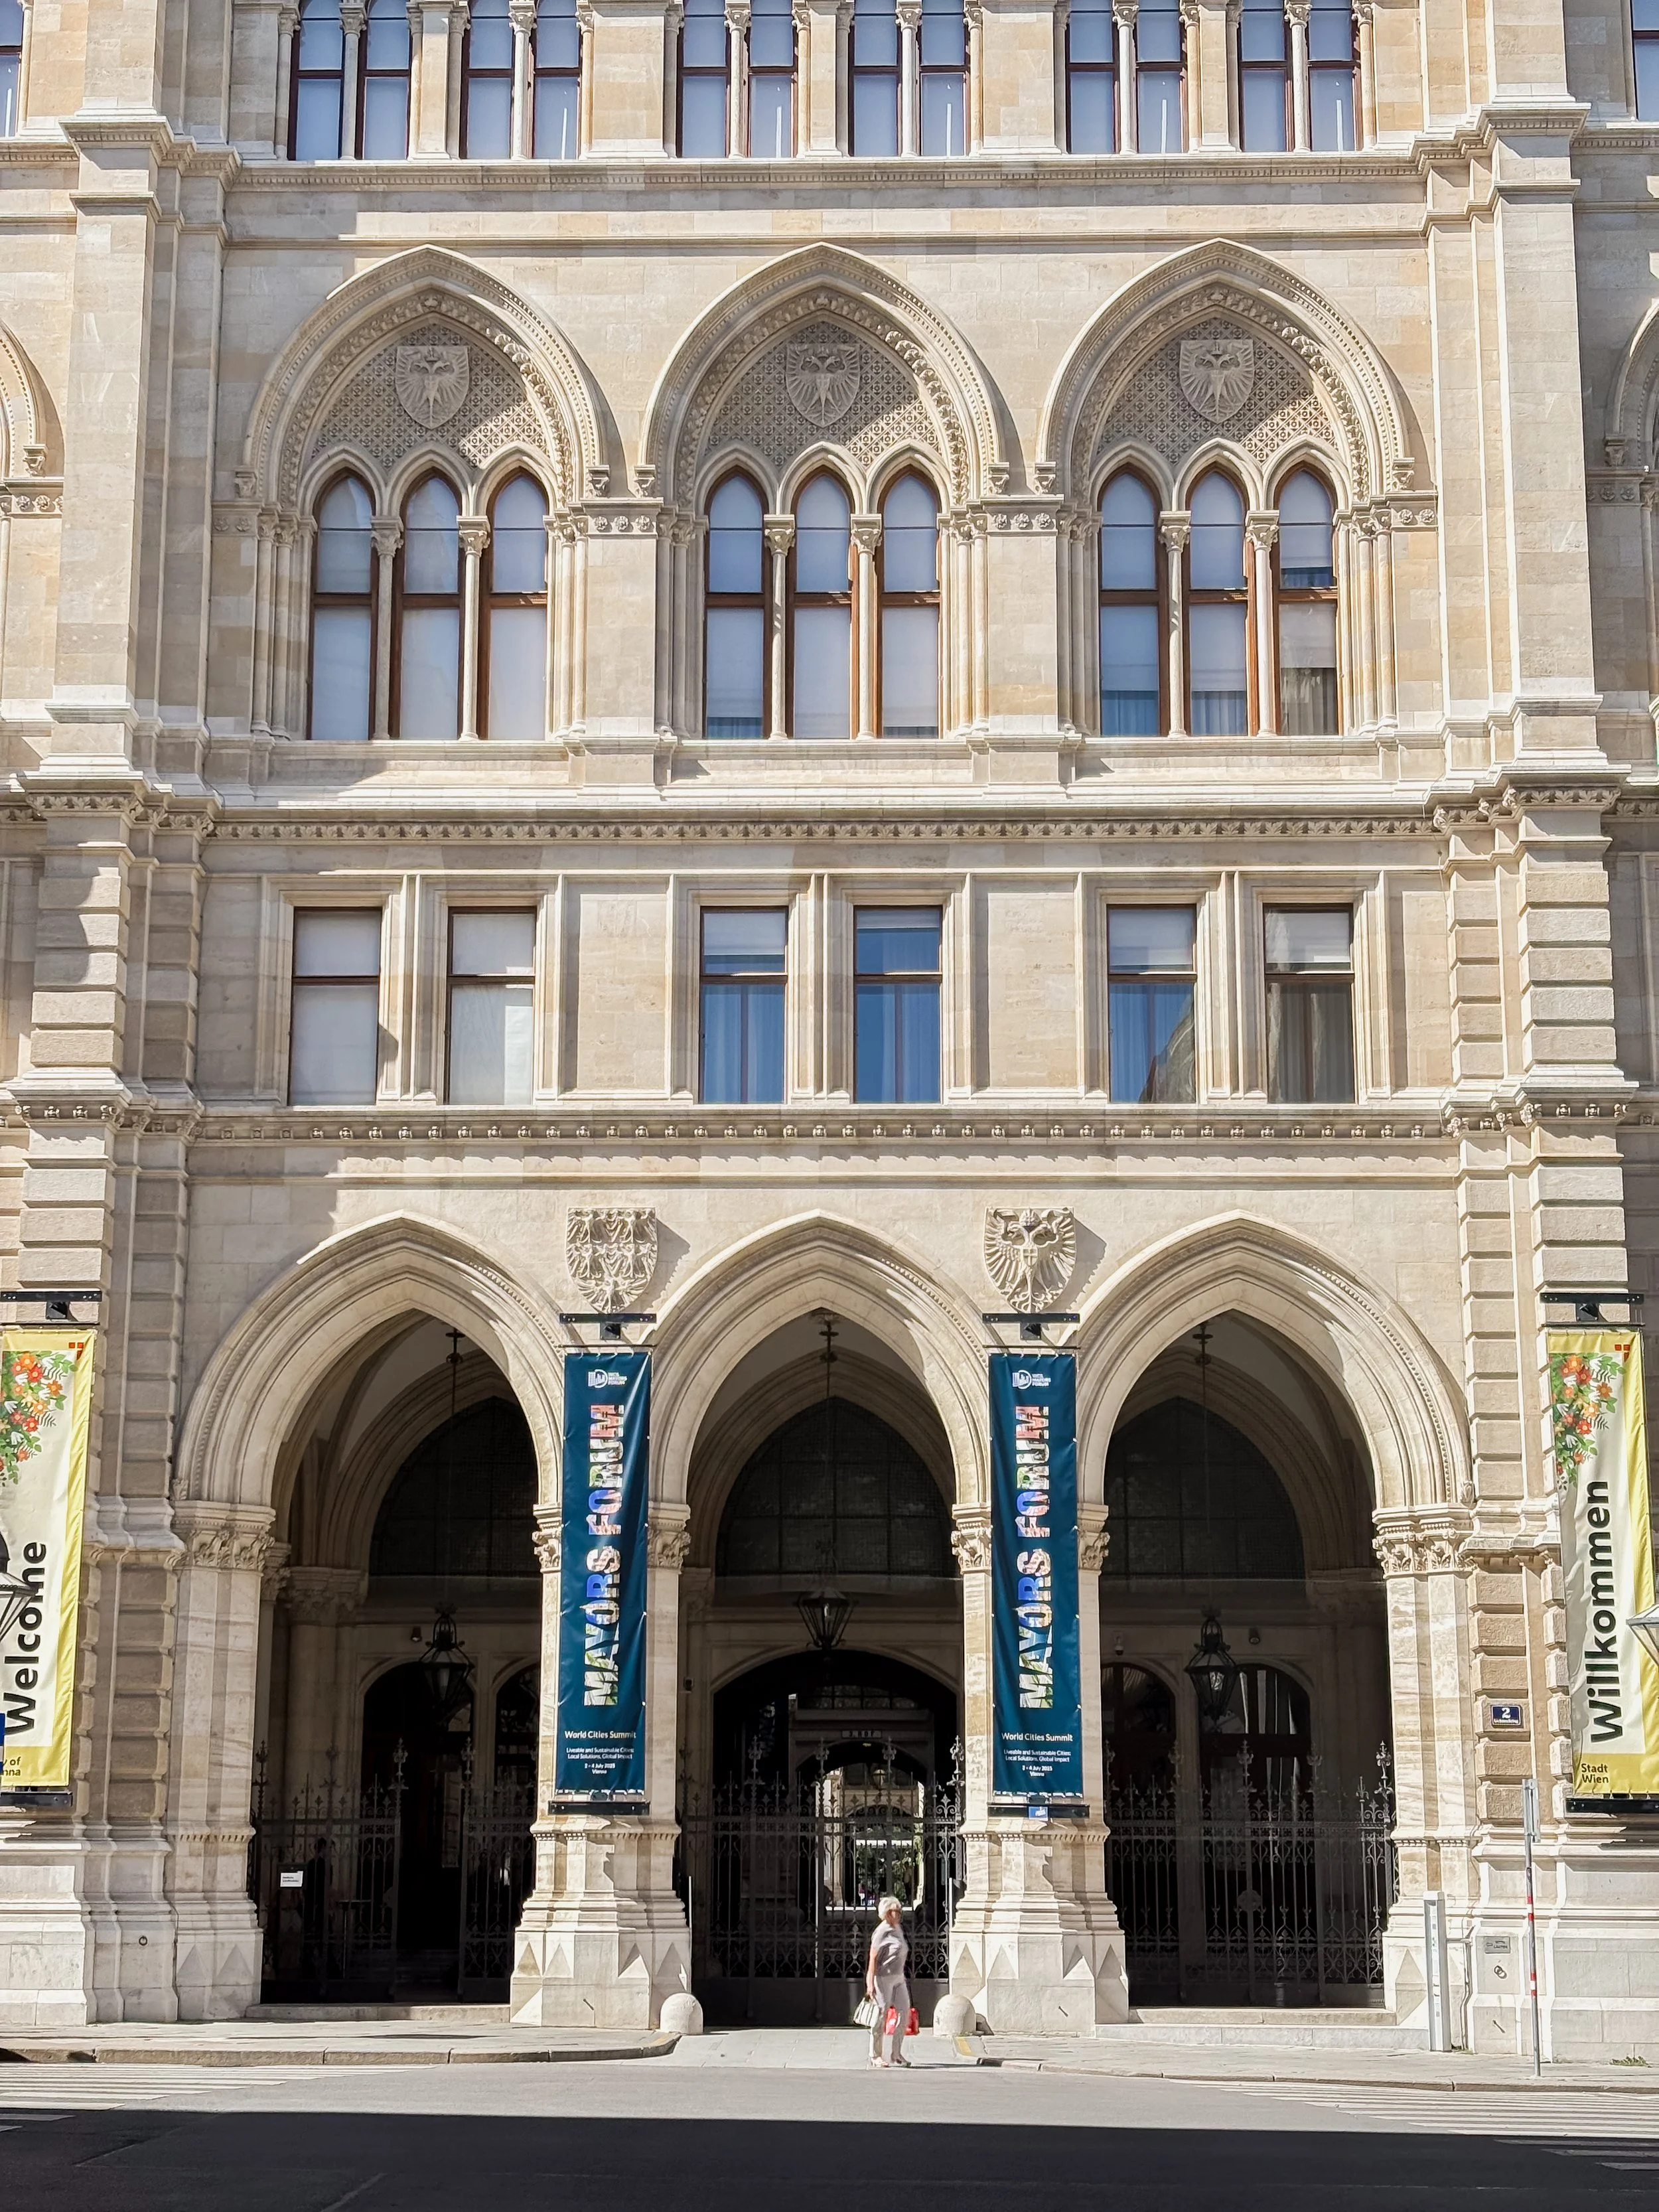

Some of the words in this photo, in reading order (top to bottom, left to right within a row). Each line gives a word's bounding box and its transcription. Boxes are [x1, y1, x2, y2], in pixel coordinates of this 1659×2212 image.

[585, 1404, 624, 1535] FORUM
[1015, 1406, 1050, 1537] FORUM
[584, 1546, 621, 1706] MAYORS
[1016, 1548, 1053, 1709] MAYORS
[1585, 1481, 1623, 1742] Willkommen
[1001, 1732, 1023, 1741] World
[1501, 1707, 1511, 1719] 2
[9, 1756, 21, 1765] of
[1581, 1763, 1608, 1773] Stadt
[1581, 1773, 1609, 1783] Wien
